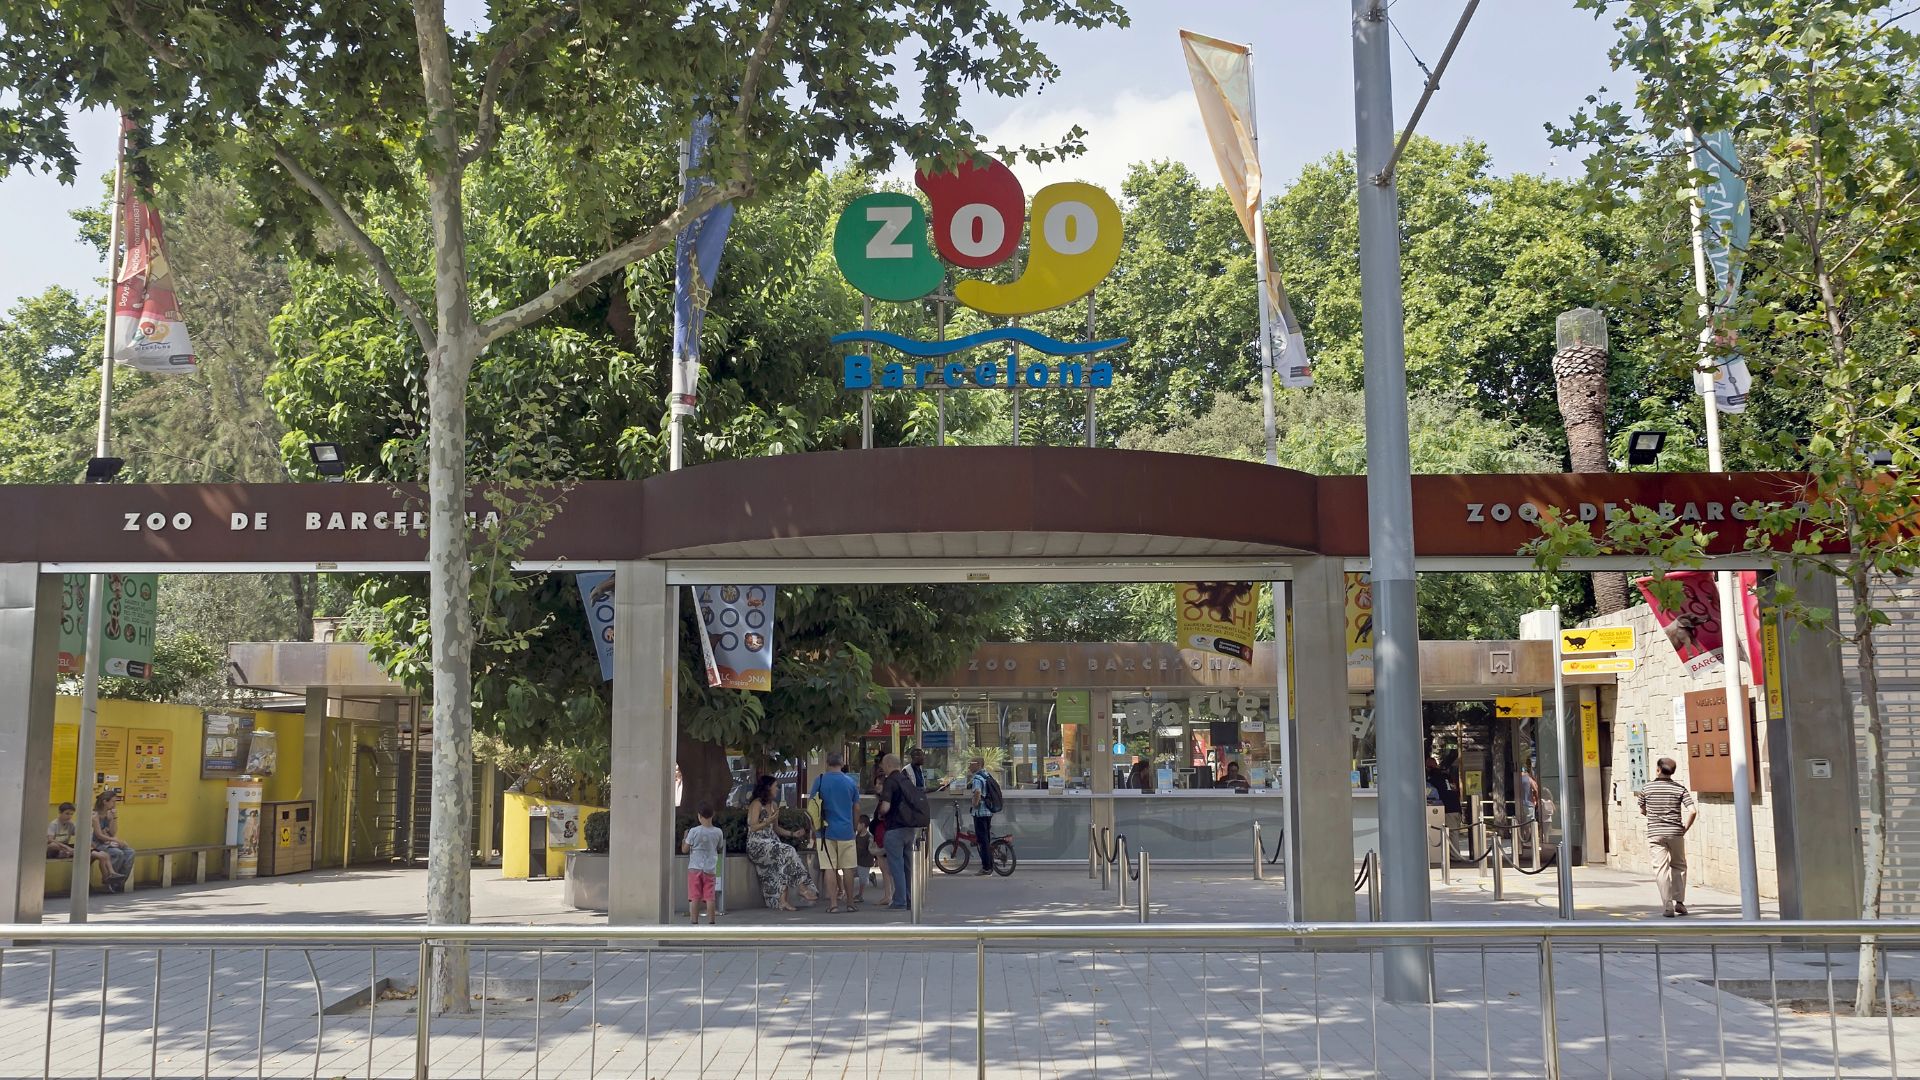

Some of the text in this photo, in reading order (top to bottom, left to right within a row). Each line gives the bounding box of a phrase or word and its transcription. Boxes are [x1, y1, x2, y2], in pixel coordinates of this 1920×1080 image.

[844, 353, 1113, 390] Barcelona
[123, 511, 500, 531] ZOO DE BARCELNA
[1467, 502, 1538, 522] ZOO
[969, 657, 1241, 671] ZOO DE BARCELONA
